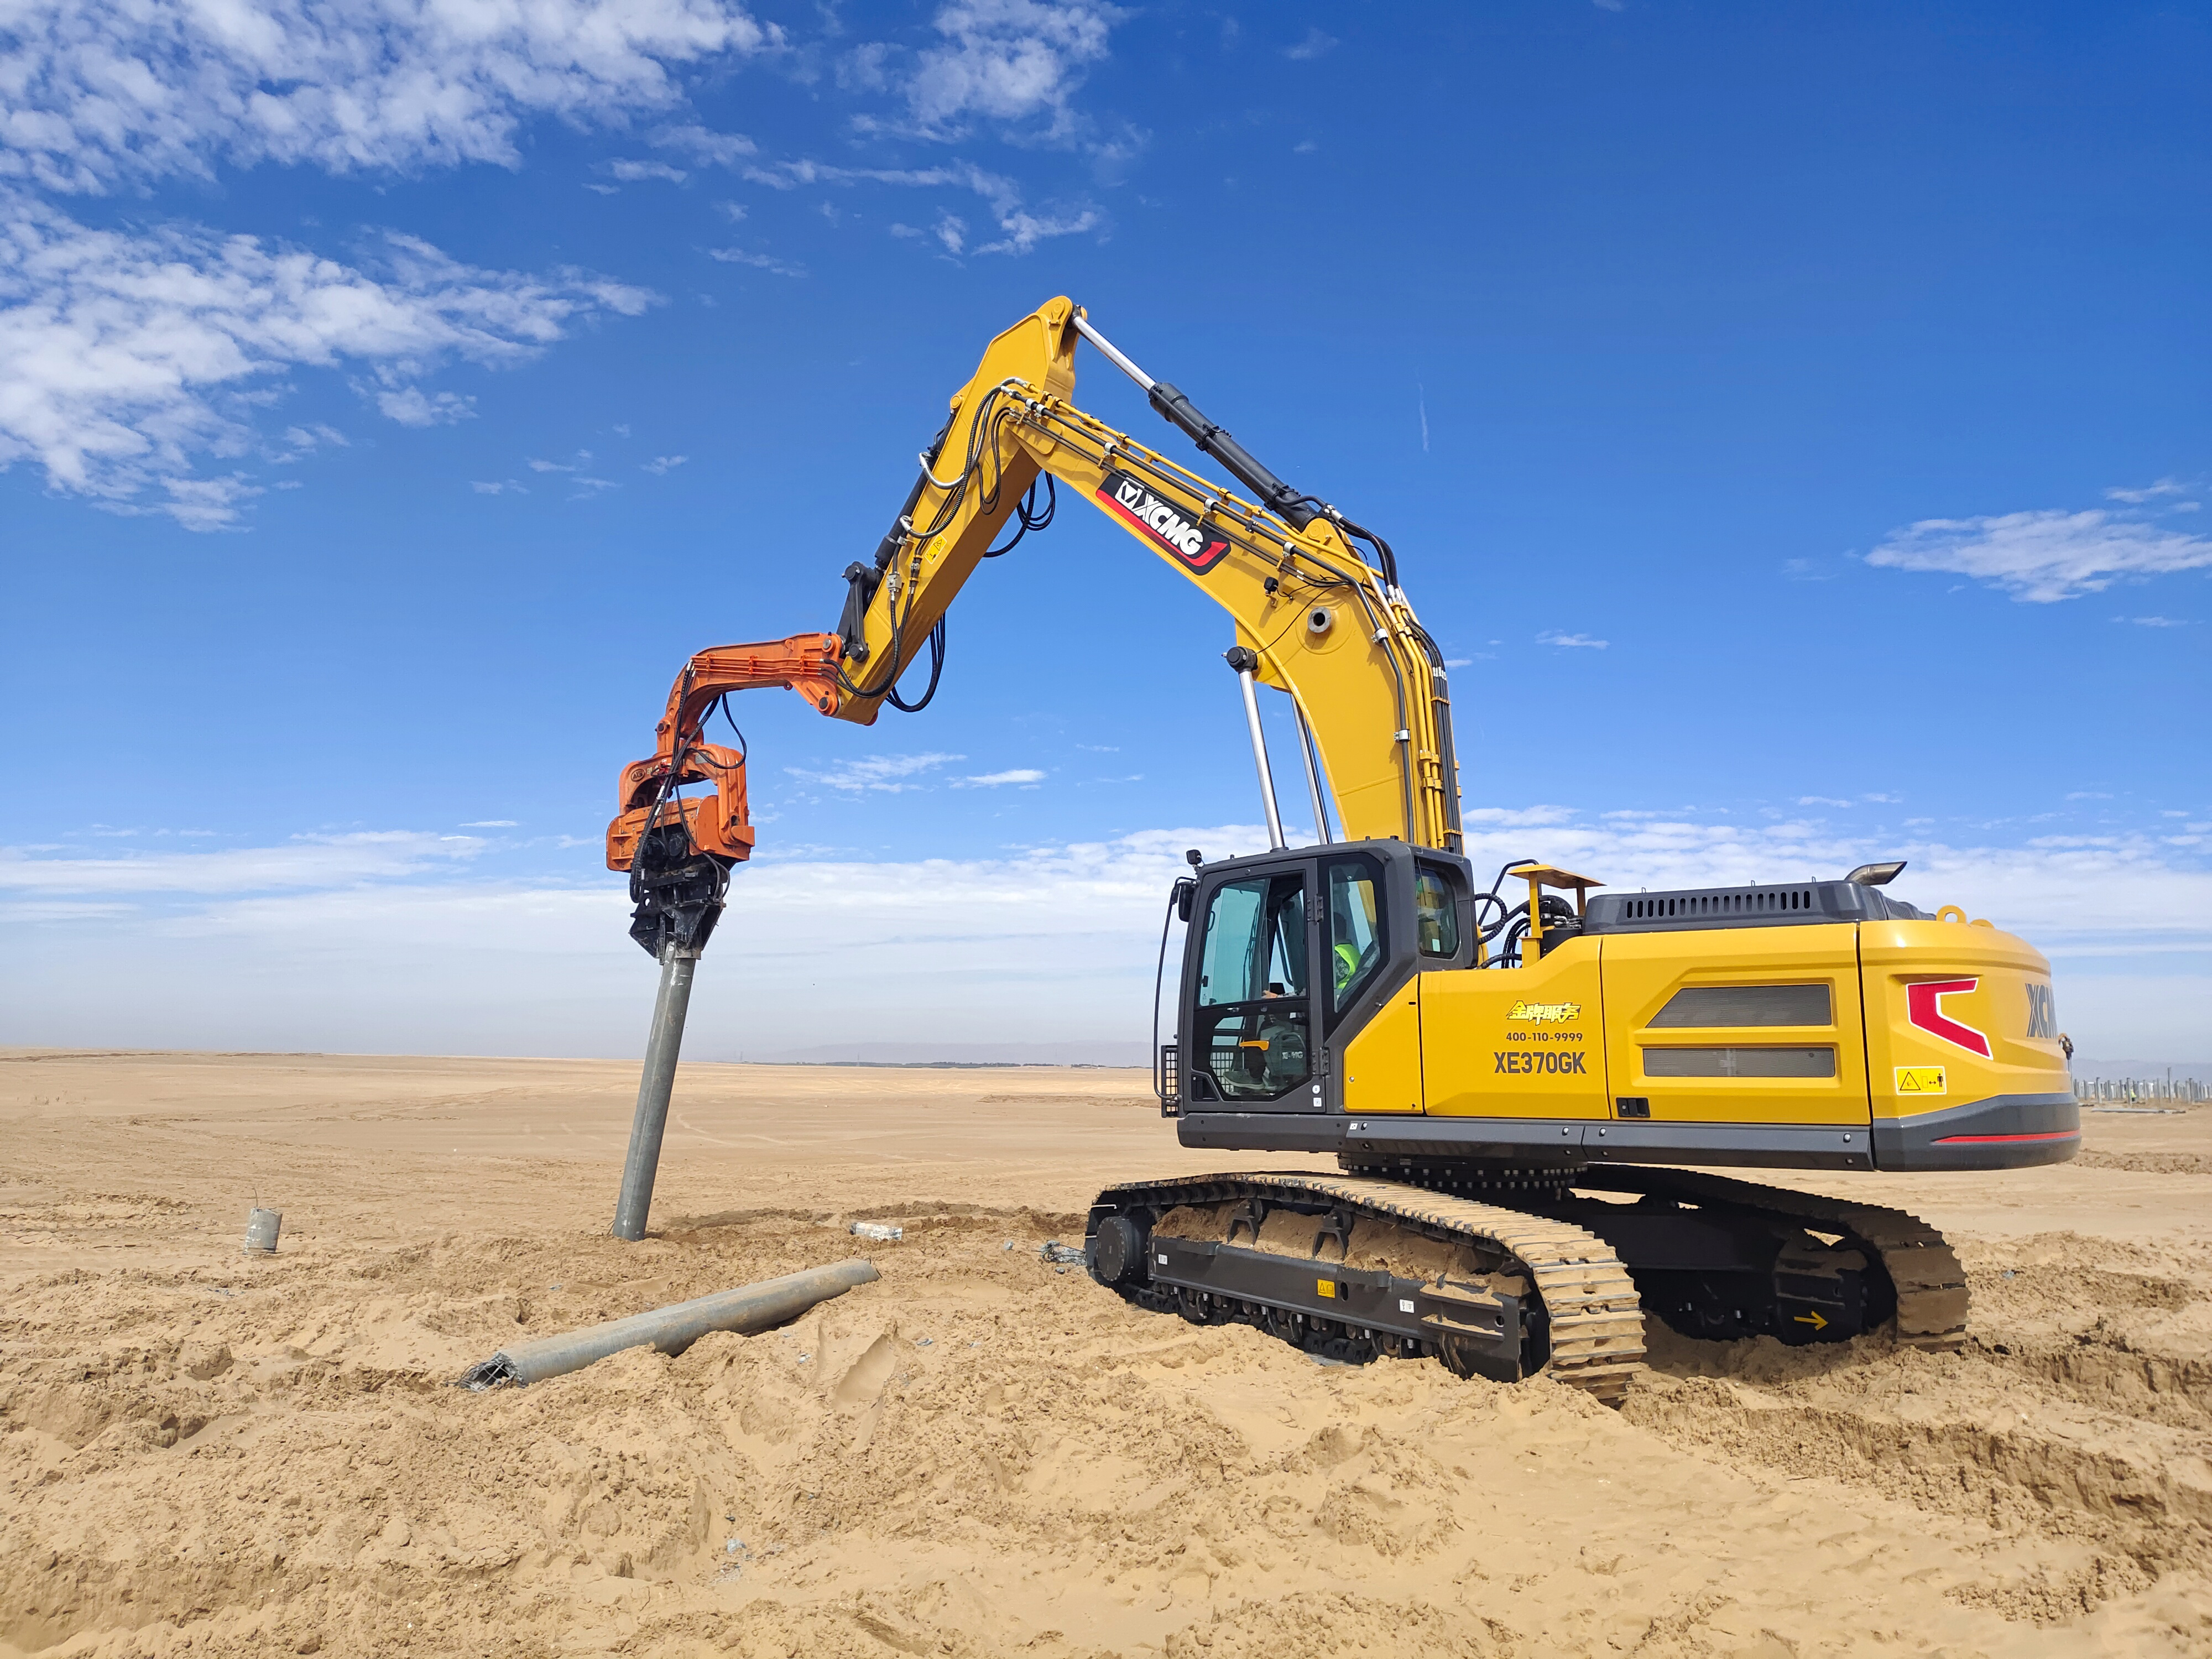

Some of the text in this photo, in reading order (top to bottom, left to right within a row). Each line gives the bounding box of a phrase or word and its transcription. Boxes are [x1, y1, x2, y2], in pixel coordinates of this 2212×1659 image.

[1131, 493, 1203, 555] XCMG
[1505, 1000, 1582, 1026] 金牌服务
[1506, 1032, 1583, 1041] 400-110-9999
[1493, 1051, 1587, 1074] XE370GK
